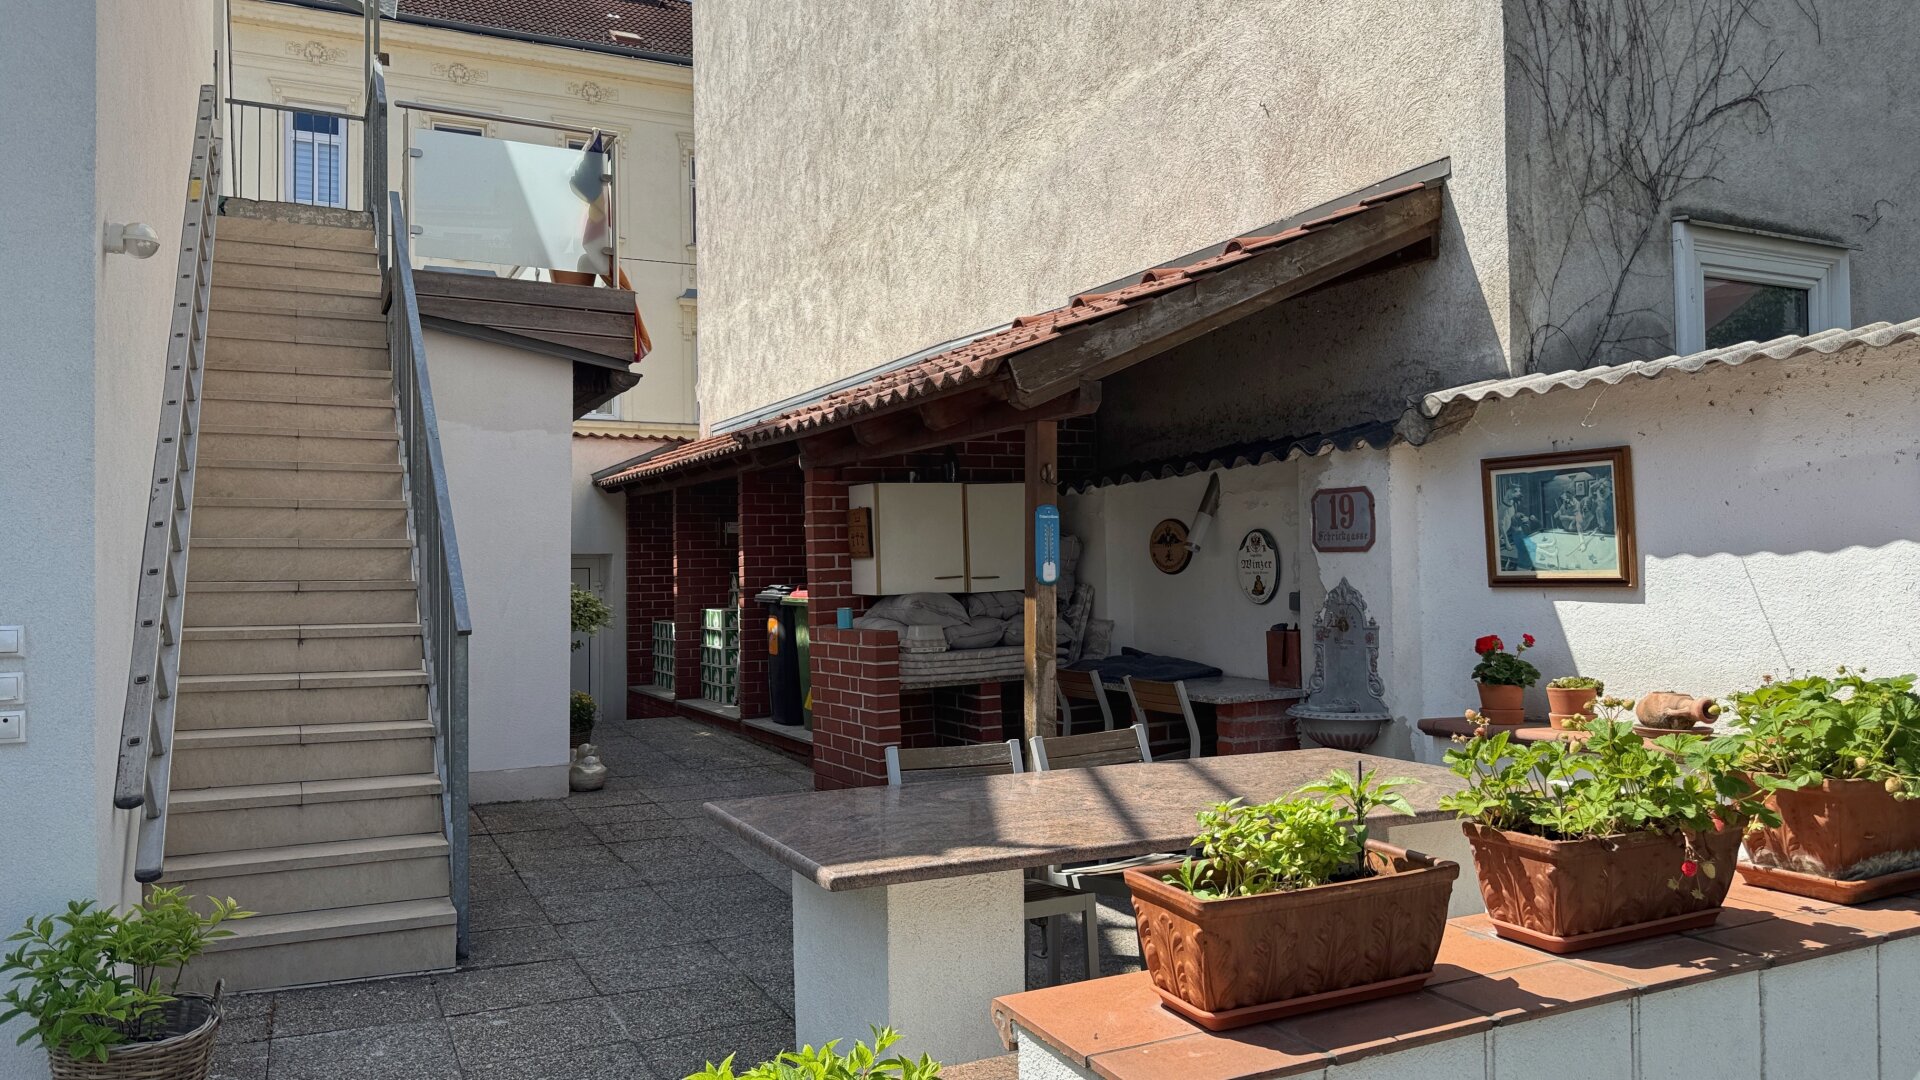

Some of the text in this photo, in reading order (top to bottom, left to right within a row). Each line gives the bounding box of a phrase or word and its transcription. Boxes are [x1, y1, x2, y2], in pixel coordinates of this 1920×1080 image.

[1329, 494, 1354, 529] 19
[1318, 531, 1367, 542] Schrickgasse
[1241, 559, 1272, 570] Winzer
